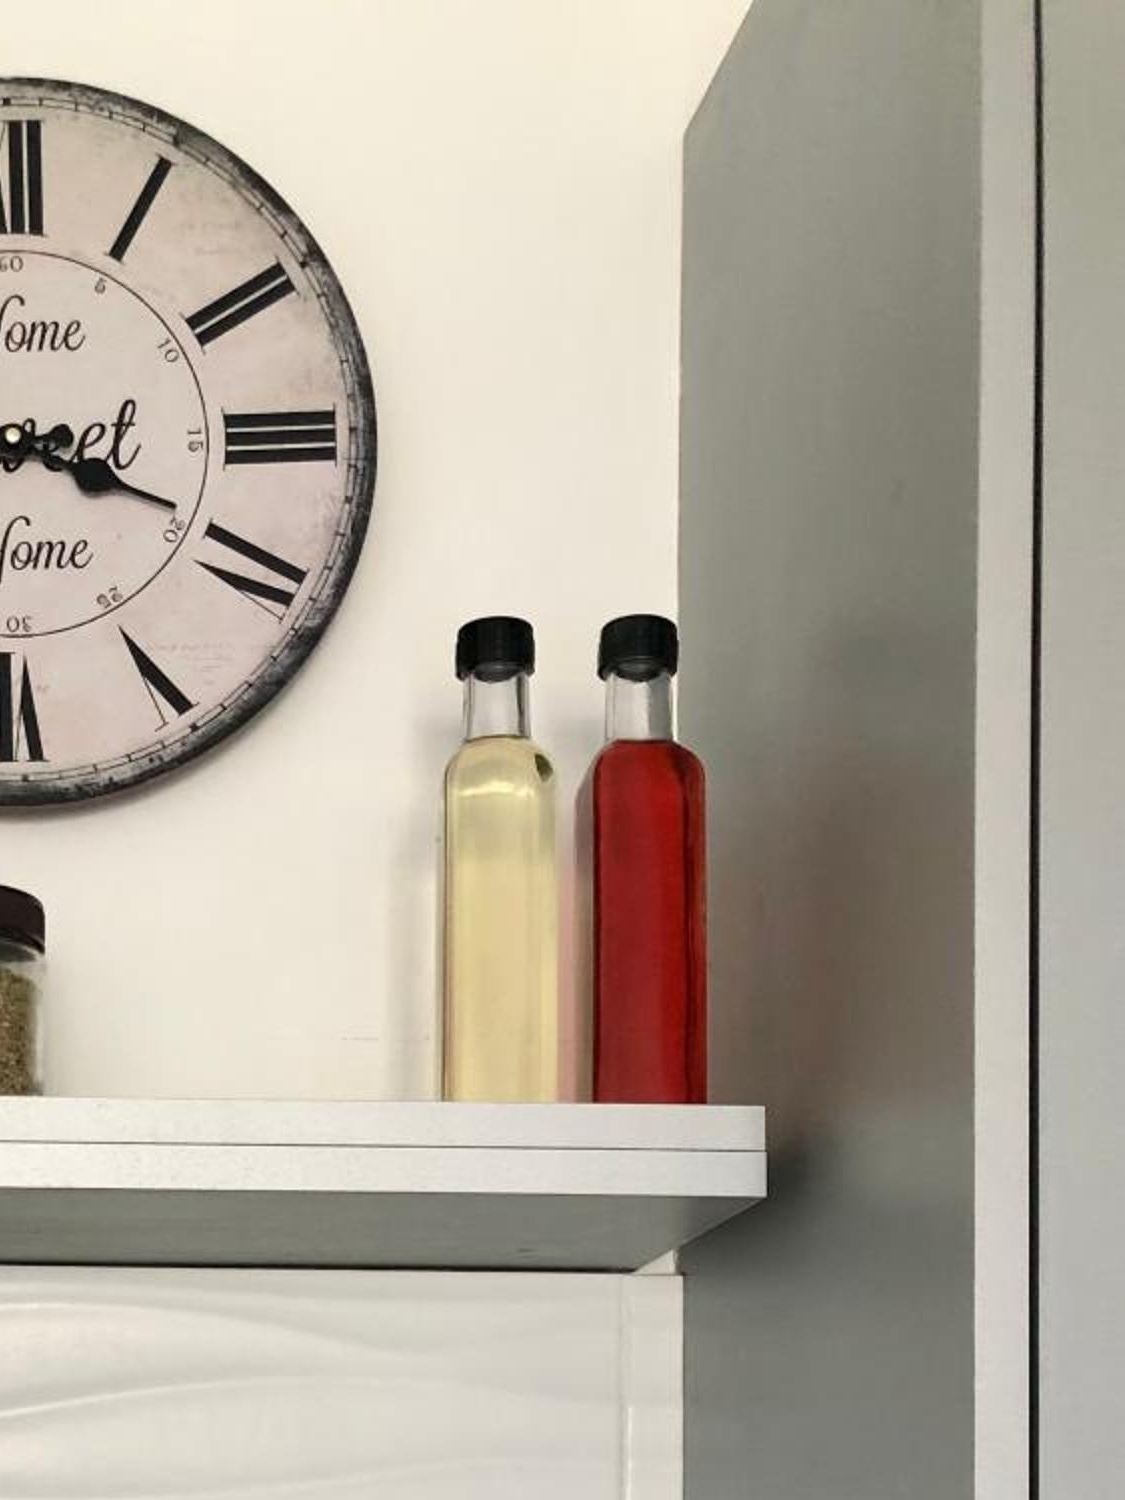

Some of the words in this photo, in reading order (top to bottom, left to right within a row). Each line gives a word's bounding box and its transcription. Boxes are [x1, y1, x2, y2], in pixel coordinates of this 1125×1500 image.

[93, 277, 107, 294] 5
[179, 257, 301, 355] II
[156, 336, 180, 364] 10
[186, 428, 203, 455] 15
[221, 403, 338, 470] III
[193, 518, 311, 625] IV
[95, 585, 124, 609] 25
[5, 615, 32, 633] 30
[117, 622, 200, 733] V
